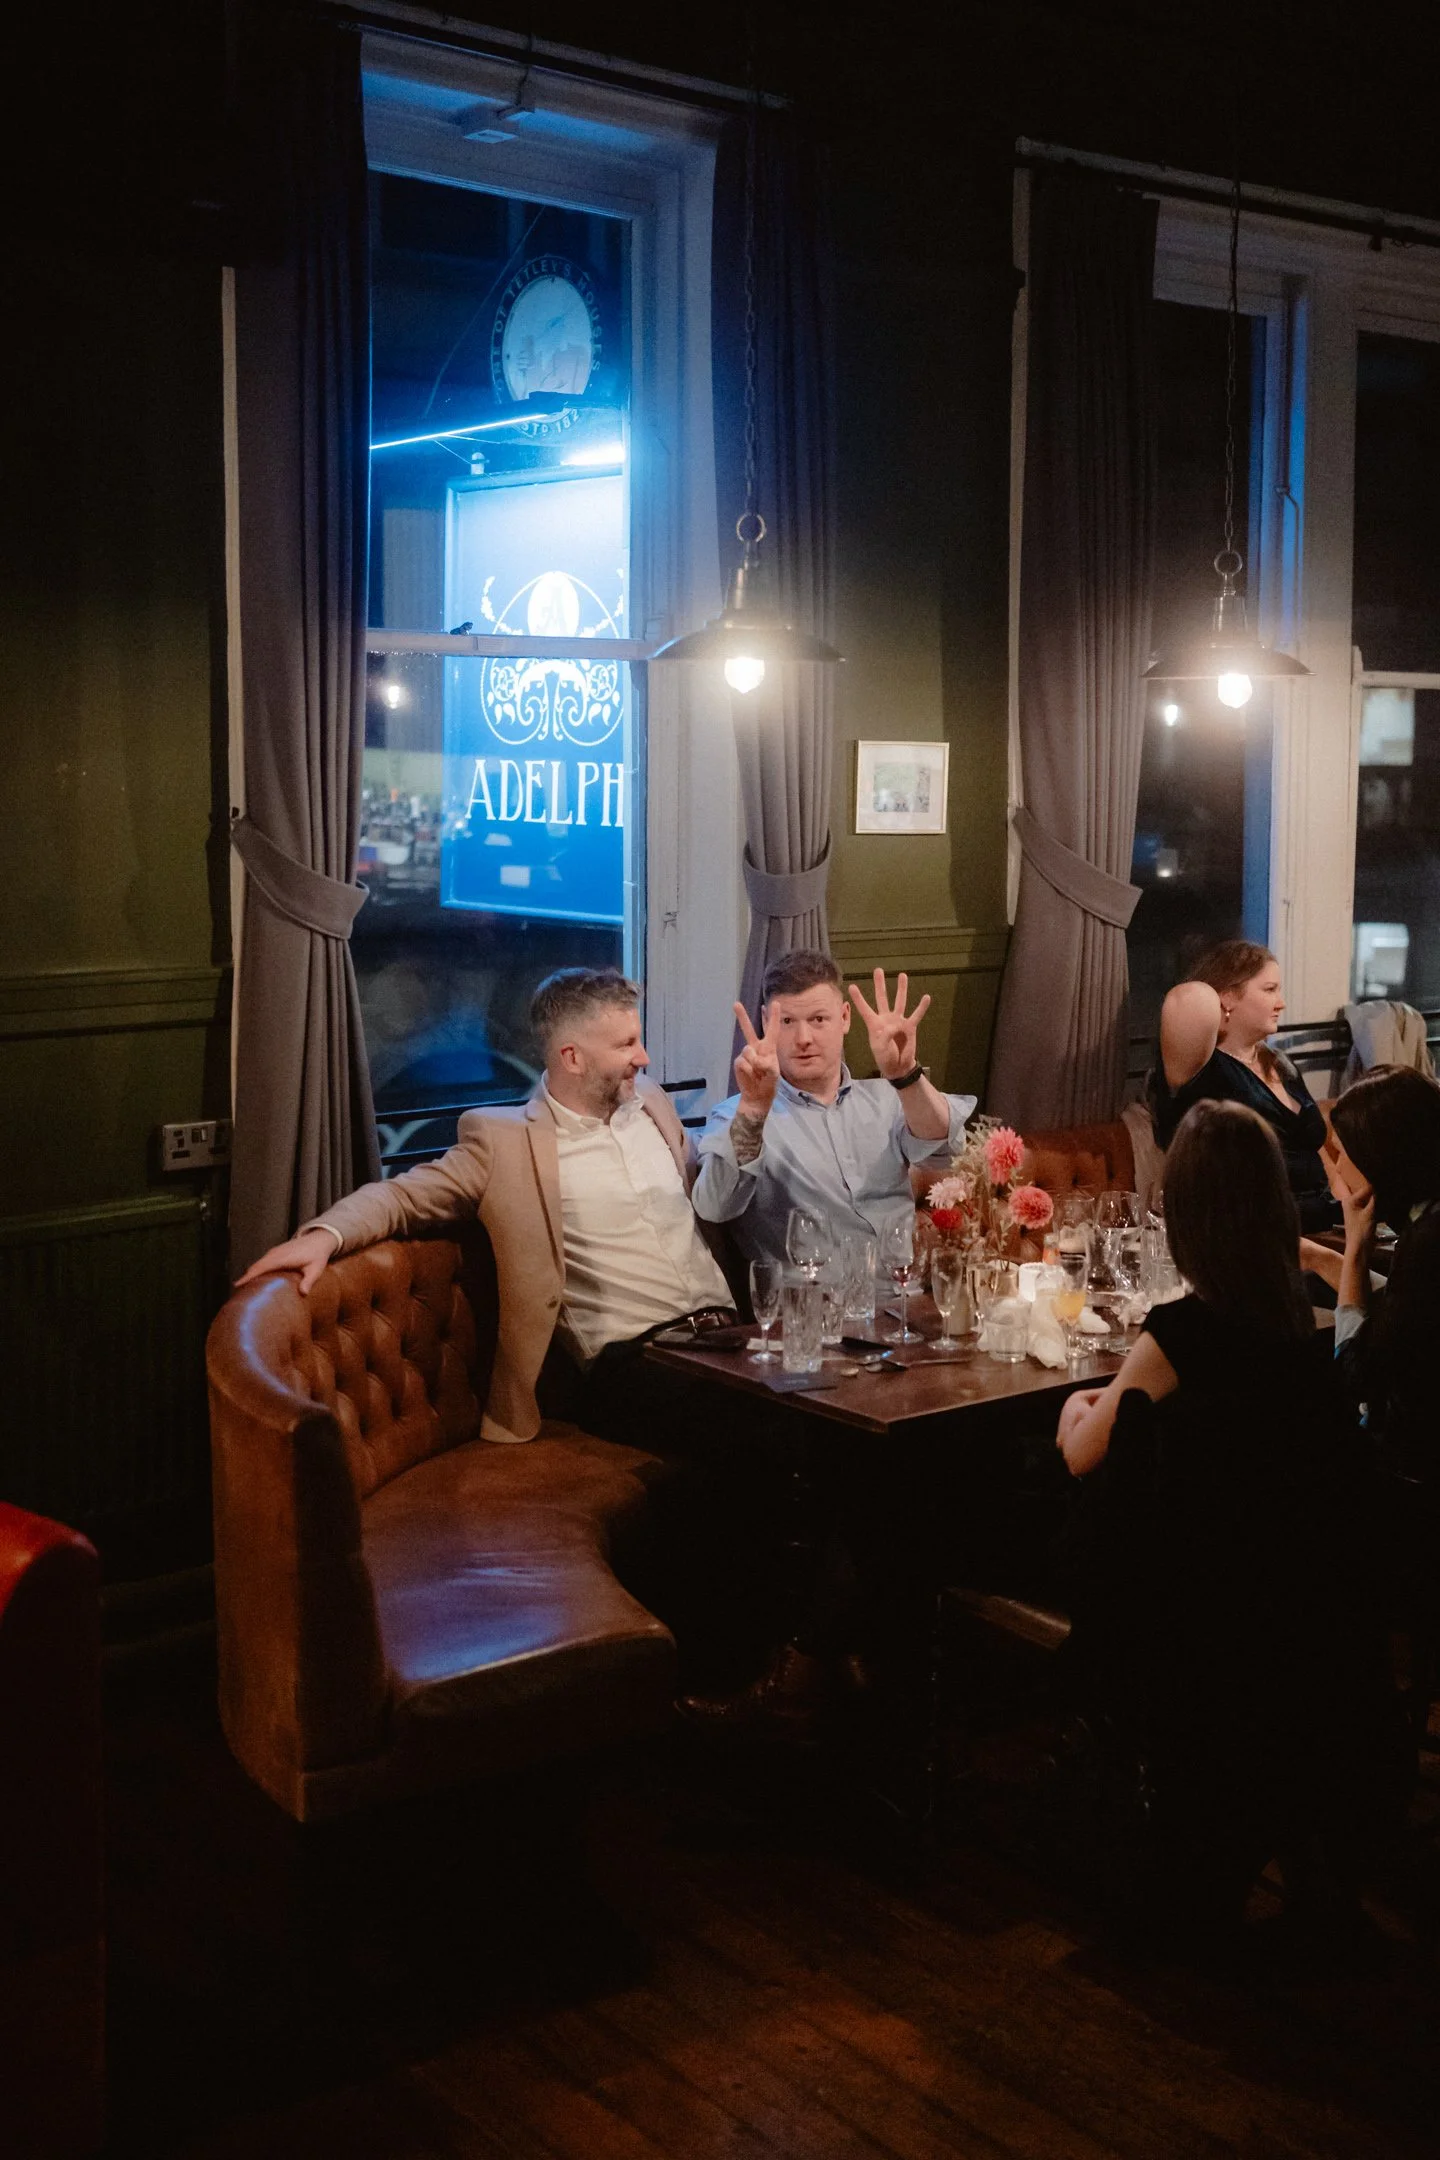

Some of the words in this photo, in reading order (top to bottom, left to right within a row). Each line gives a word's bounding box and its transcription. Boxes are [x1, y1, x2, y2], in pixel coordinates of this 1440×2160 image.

[505, 259, 572, 297] TETLEY'S
[577, 276, 602, 371] HOUSES
[520, 420, 549, 437] STD
[555, 408, 580, 434] 182
[465, 759, 624, 828] ADELPH
